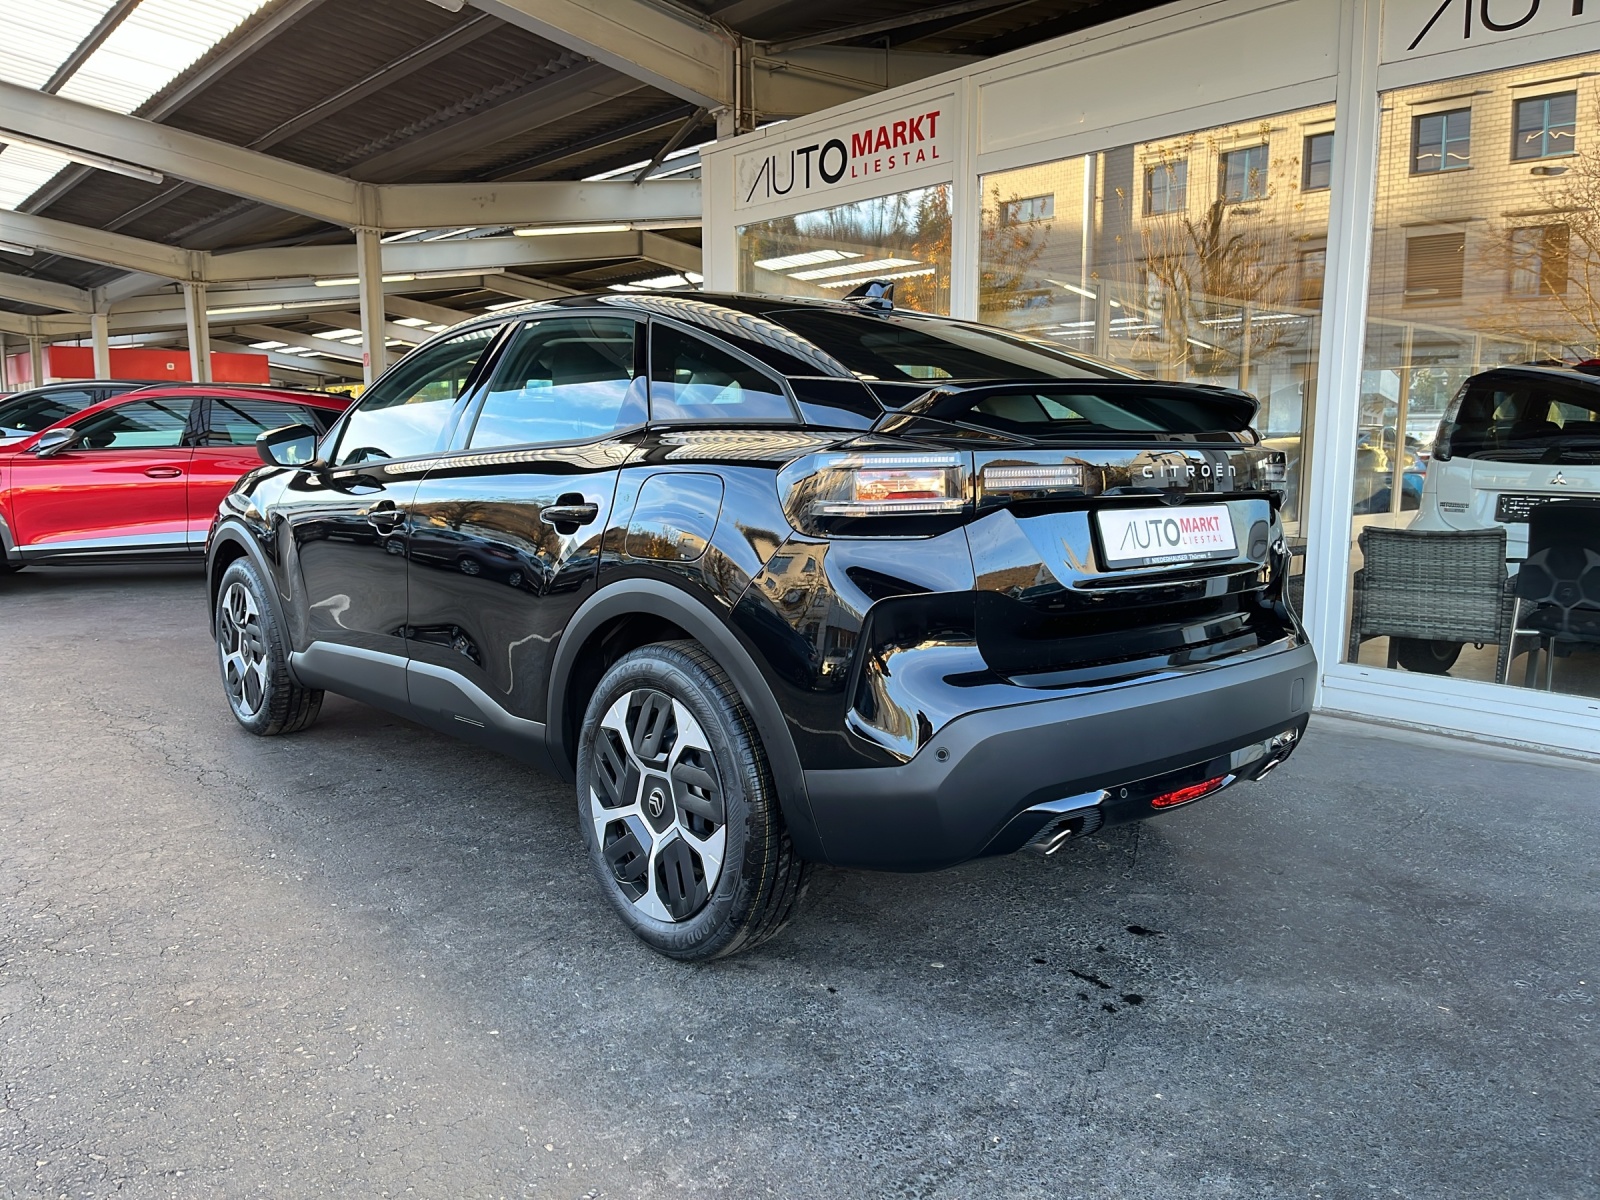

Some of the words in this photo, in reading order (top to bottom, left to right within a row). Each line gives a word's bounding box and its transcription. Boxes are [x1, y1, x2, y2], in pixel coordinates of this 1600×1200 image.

[746, 138, 848, 202] AUTO
[851, 110, 941, 158] MARKT
[851, 145, 940, 178] LIESTAL
[1120, 518, 1180, 550] AUTO
[1179, 516, 1220, 533] MARKT
[1182, 535, 1224, 545] LIESTAL
